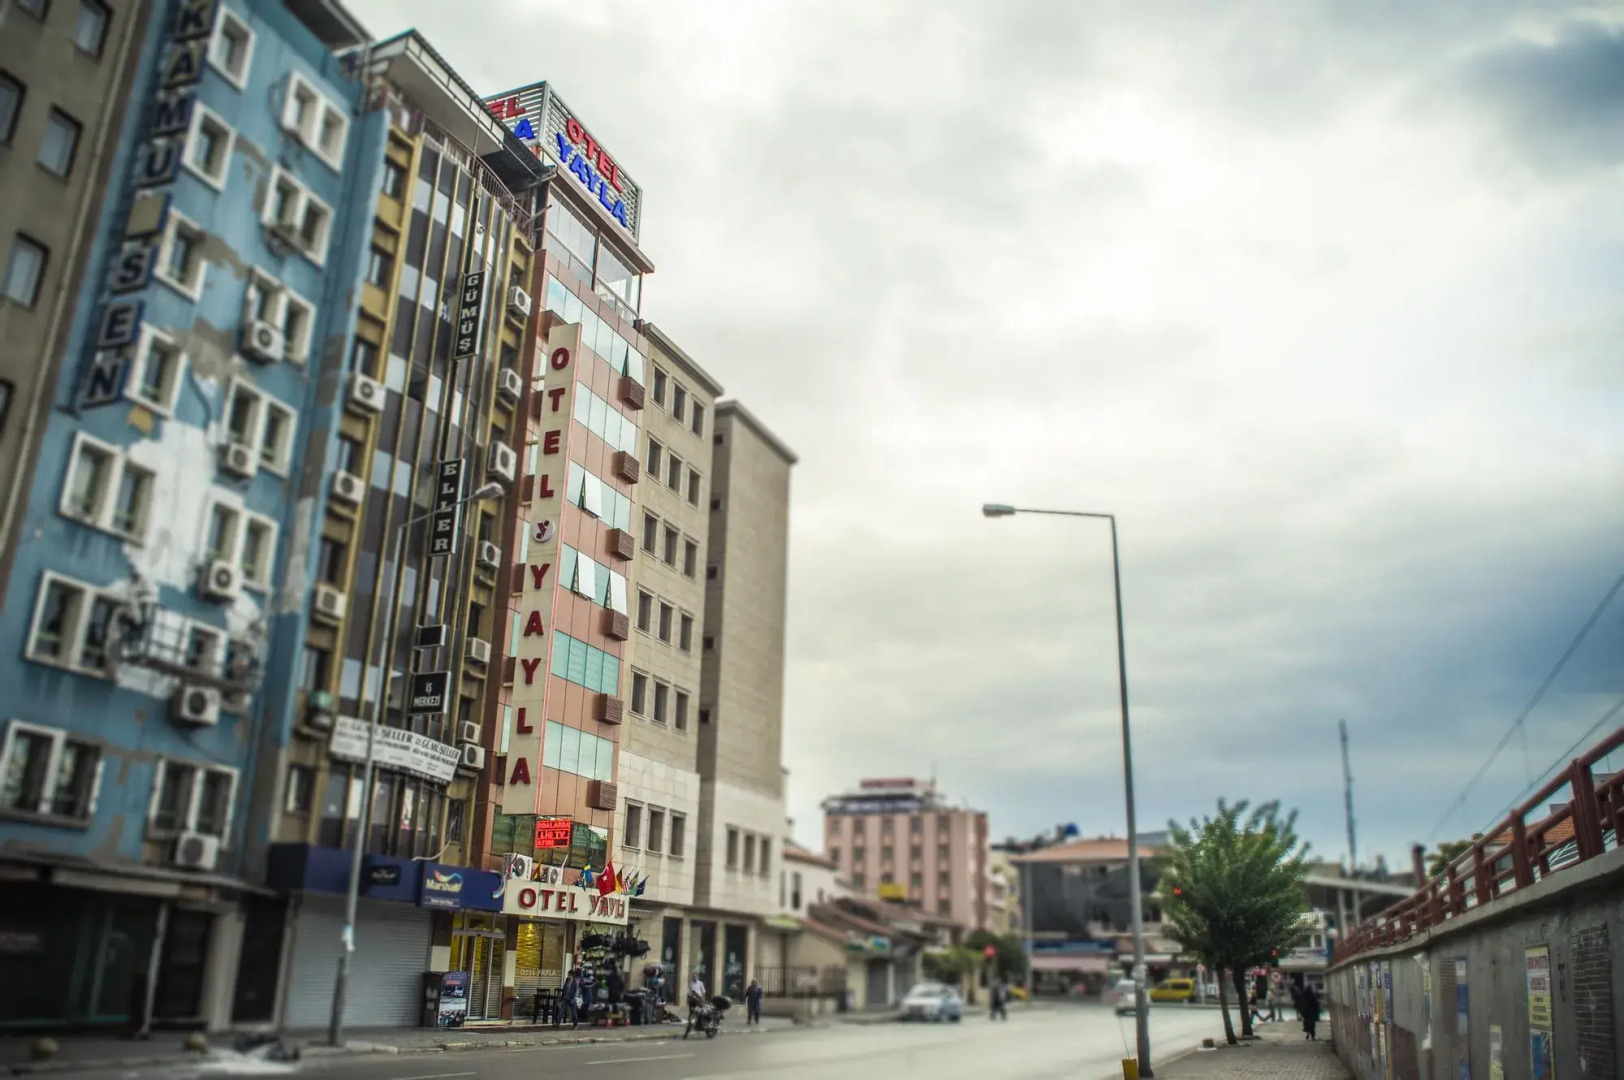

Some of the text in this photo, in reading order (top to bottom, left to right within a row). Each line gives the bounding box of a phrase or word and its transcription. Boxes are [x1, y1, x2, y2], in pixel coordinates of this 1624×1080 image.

[556, 132, 628, 228] YAYLA
[566, 118, 623, 193] OTEL
[87, 251, 147, 399] SEN
[458, 275, 480, 352] GÜMÜŞ
[540, 347, 570, 498] OTEL
[434, 463, 458, 551] ELLER
[509, 563, 550, 785] YAYLA
[555, 830, 566, 838] TV
[518, 888, 578, 913] OTEL
[519, 967, 535, 976] OTEL
